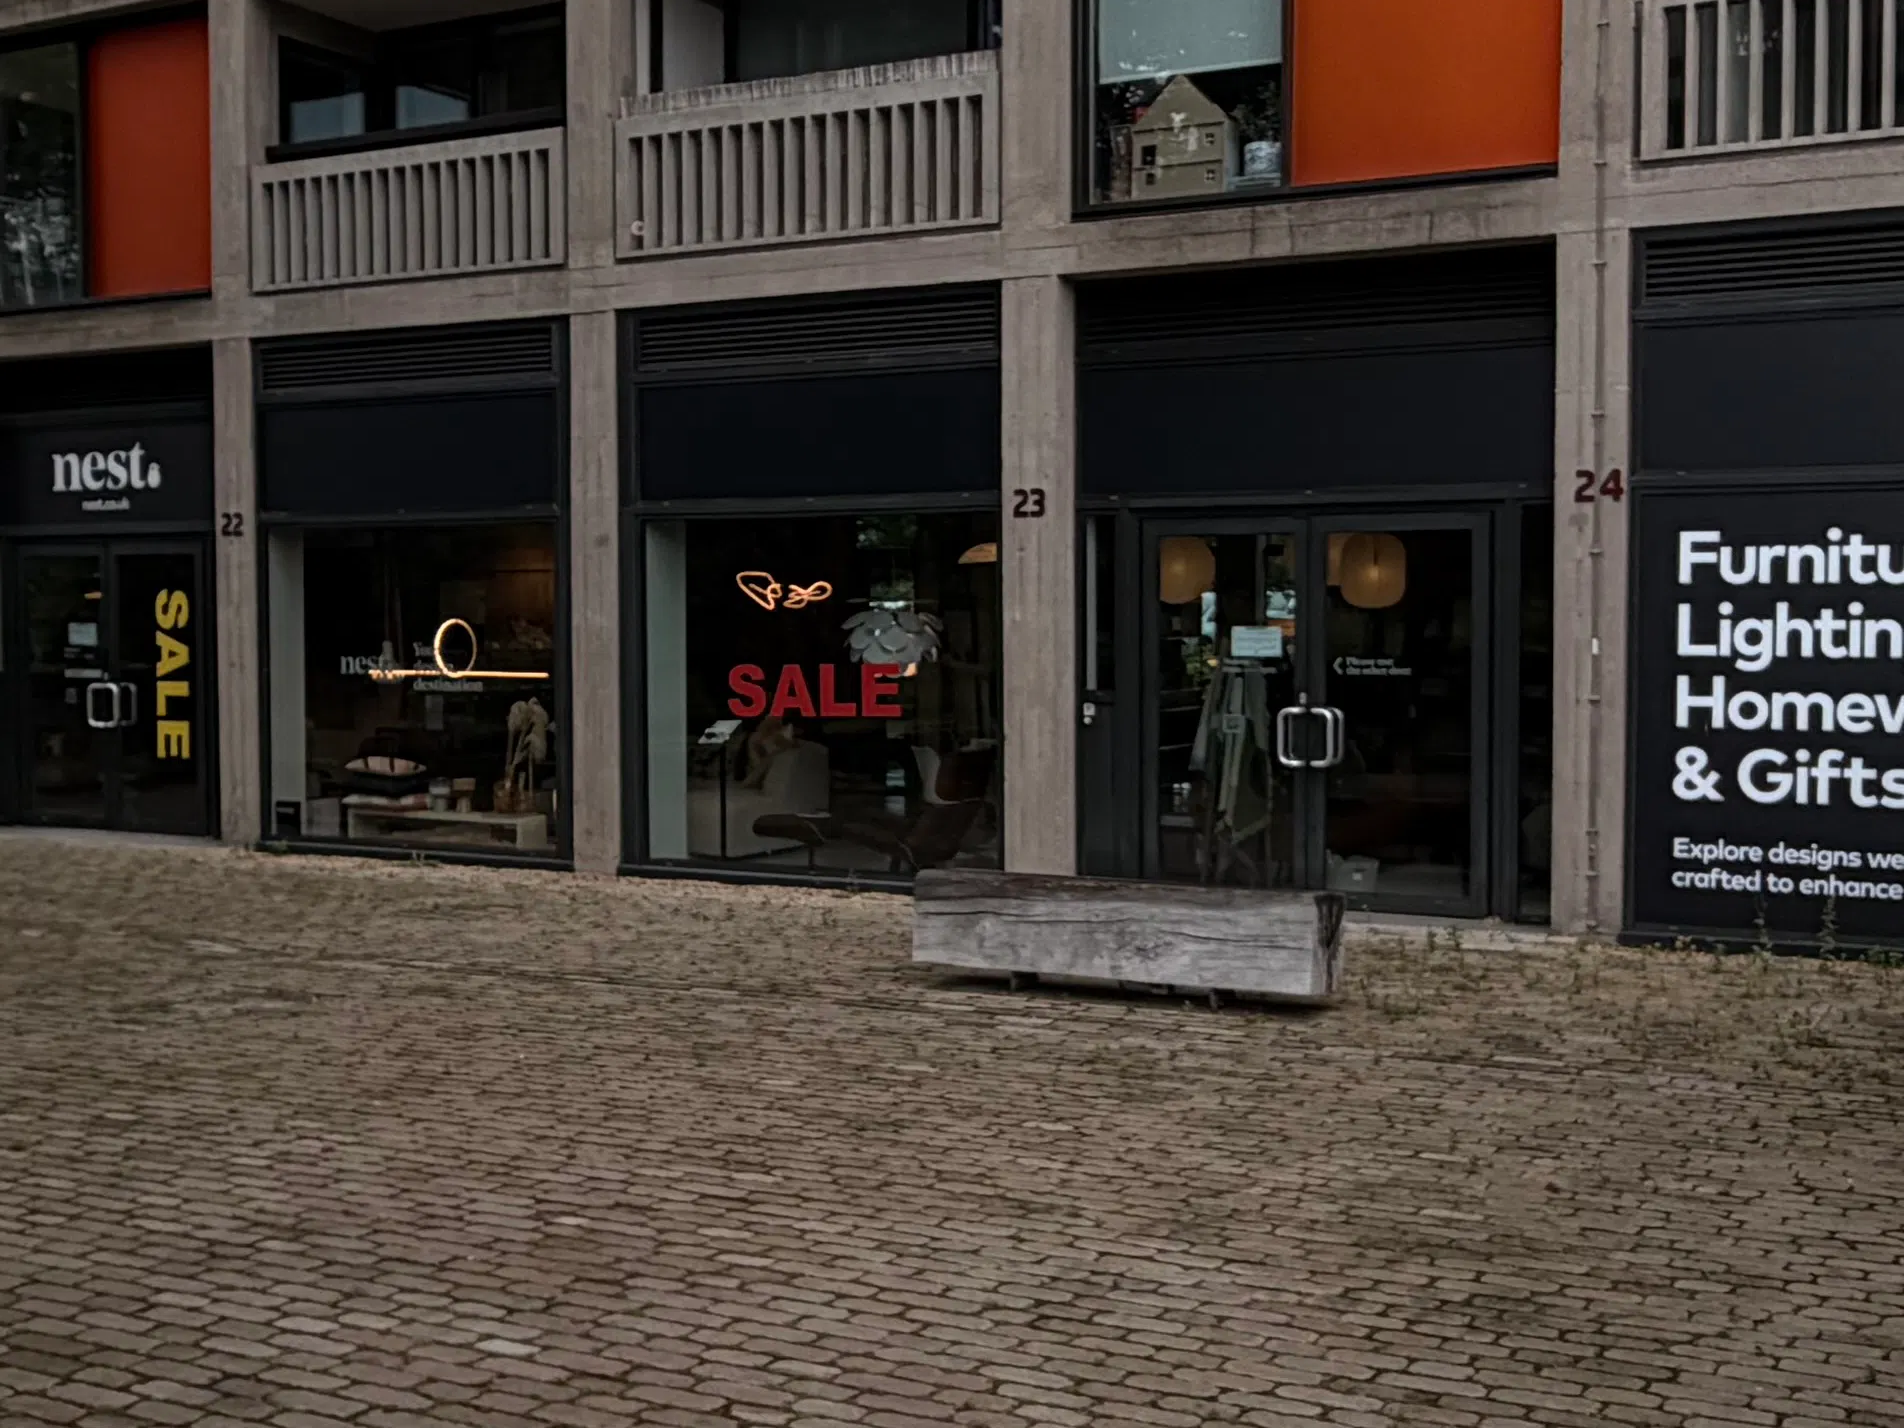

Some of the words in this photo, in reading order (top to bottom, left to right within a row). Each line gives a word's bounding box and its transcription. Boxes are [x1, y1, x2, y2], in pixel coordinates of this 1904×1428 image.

[1012, 488, 1046, 519] 23
[1574, 467, 1626, 504] 24
[221, 512, 243, 537] 22
[155, 589, 191, 759] SALE
[728, 663, 904, 719] SALE
[1672, 745, 1724, 801] &
[1672, 836, 1764, 865] Explore
[1767, 841, 1863, 872] designs
[1671, 867, 1763, 892] crafted
[1766, 871, 1795, 894] to
[1798, 873, 1904, 900] enhance
